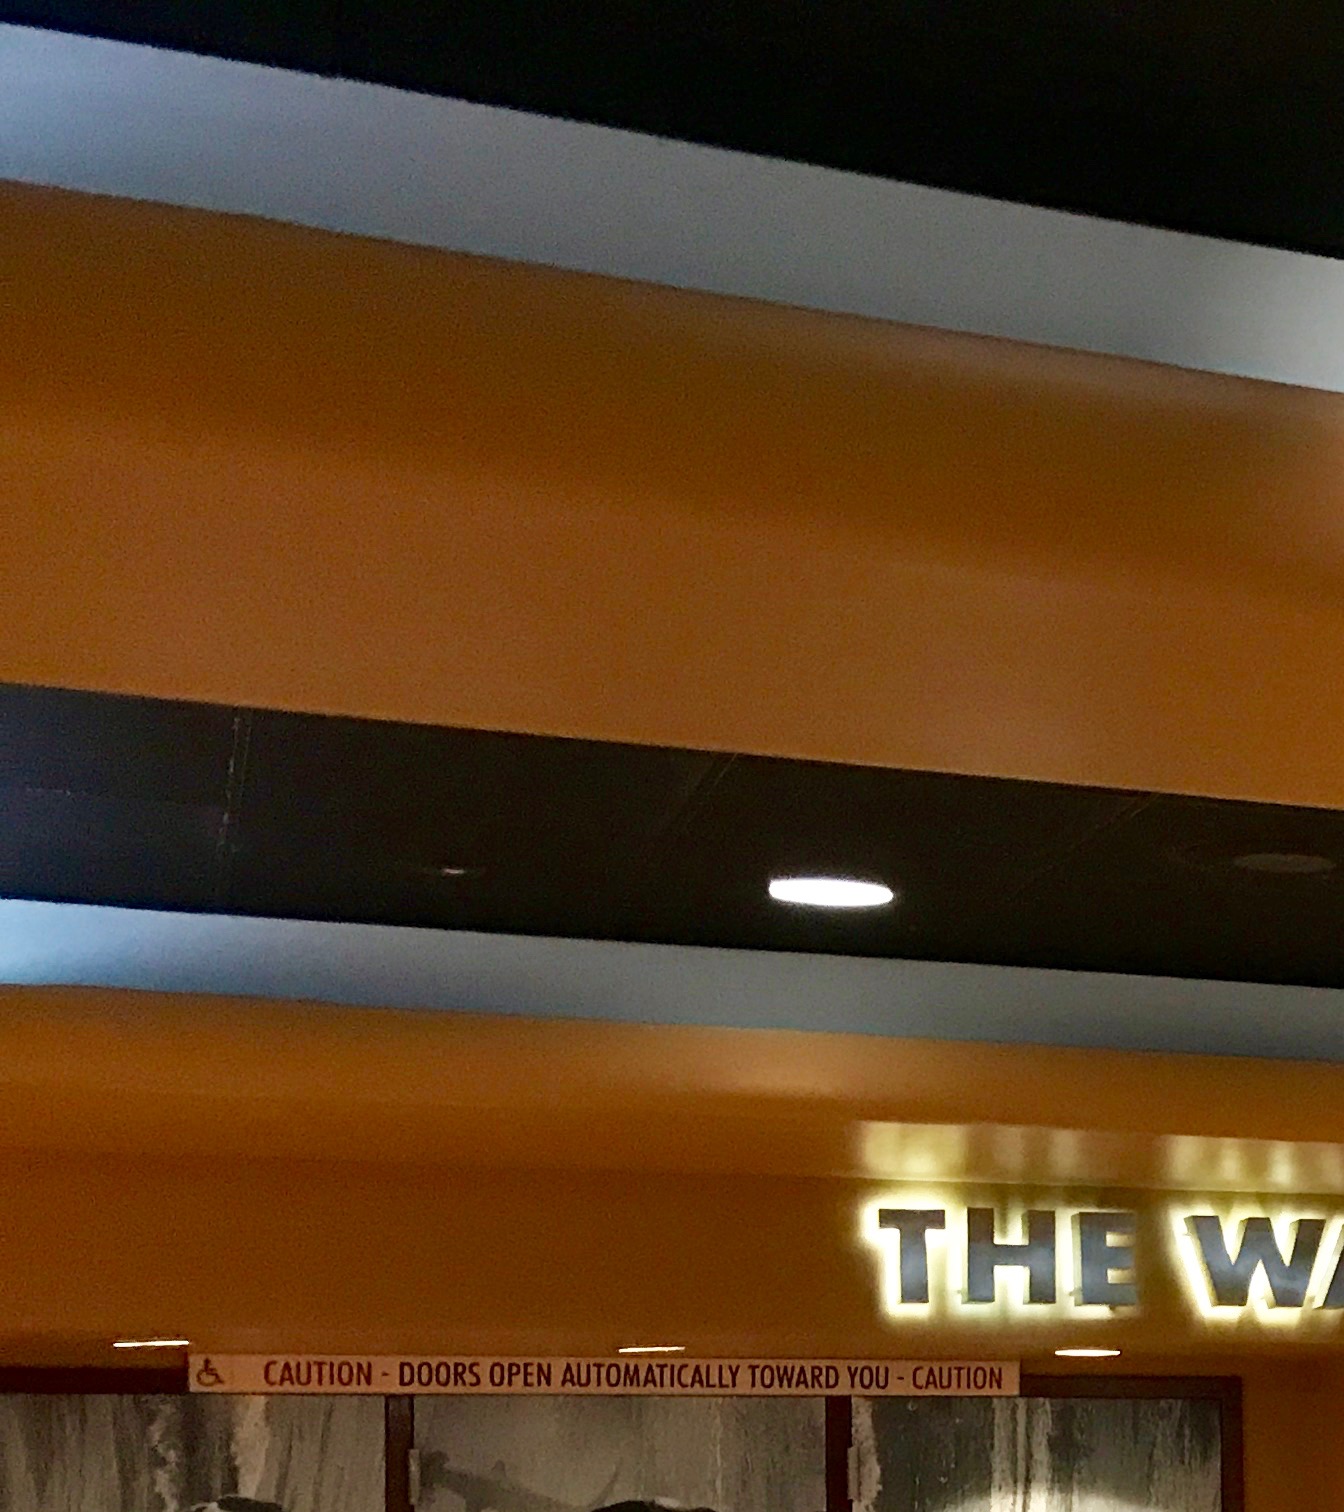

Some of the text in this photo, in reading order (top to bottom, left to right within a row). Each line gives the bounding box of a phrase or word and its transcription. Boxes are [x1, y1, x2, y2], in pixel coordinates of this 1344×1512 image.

[878, 1206, 1137, 1307] THE
[263, 1359, 373, 1387] CAUTION
[399, 1360, 482, 1388] DOORS
[488, 1361, 551, 1388] OPEN
[560, 1362, 741, 1389] AUTOMATICALLY
[748, 1363, 840, 1390] TOWARD
[847, 1364, 889, 1390] YOU
[911, 1365, 1003, 1391] CAUTION
